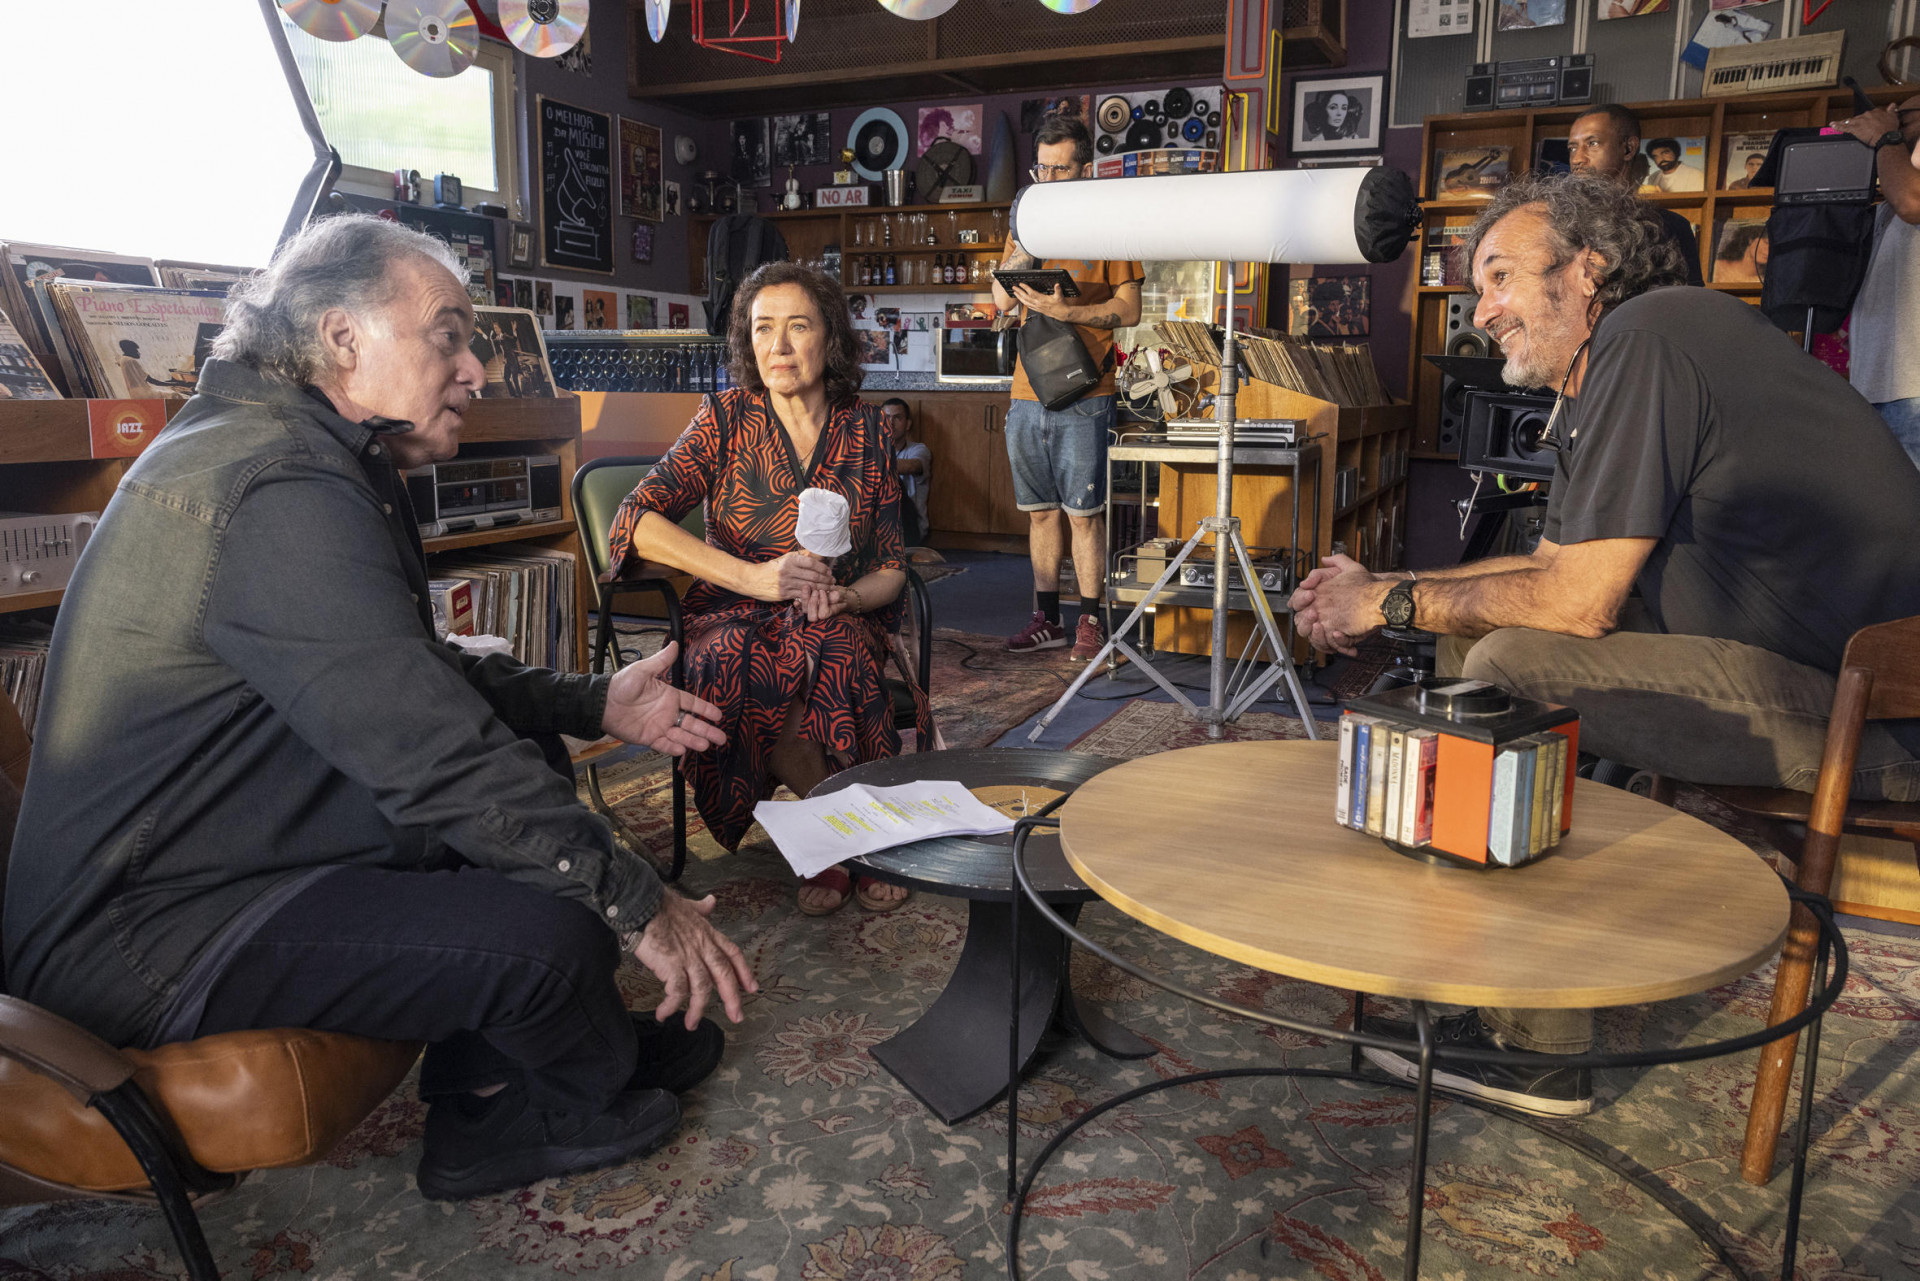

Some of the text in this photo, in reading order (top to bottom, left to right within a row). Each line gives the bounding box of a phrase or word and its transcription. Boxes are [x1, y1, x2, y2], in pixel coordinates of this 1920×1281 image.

[546, 107, 594, 131] O MELHOR
[554, 127, 567, 138] DA
[568, 127, 605, 150] MÚSICA
[821, 189, 863, 204] NO AR
[75, 295, 125, 313] Piano
[116, 422, 143, 434] JAZZ
[1390, 751, 1400, 785] MADONNA
